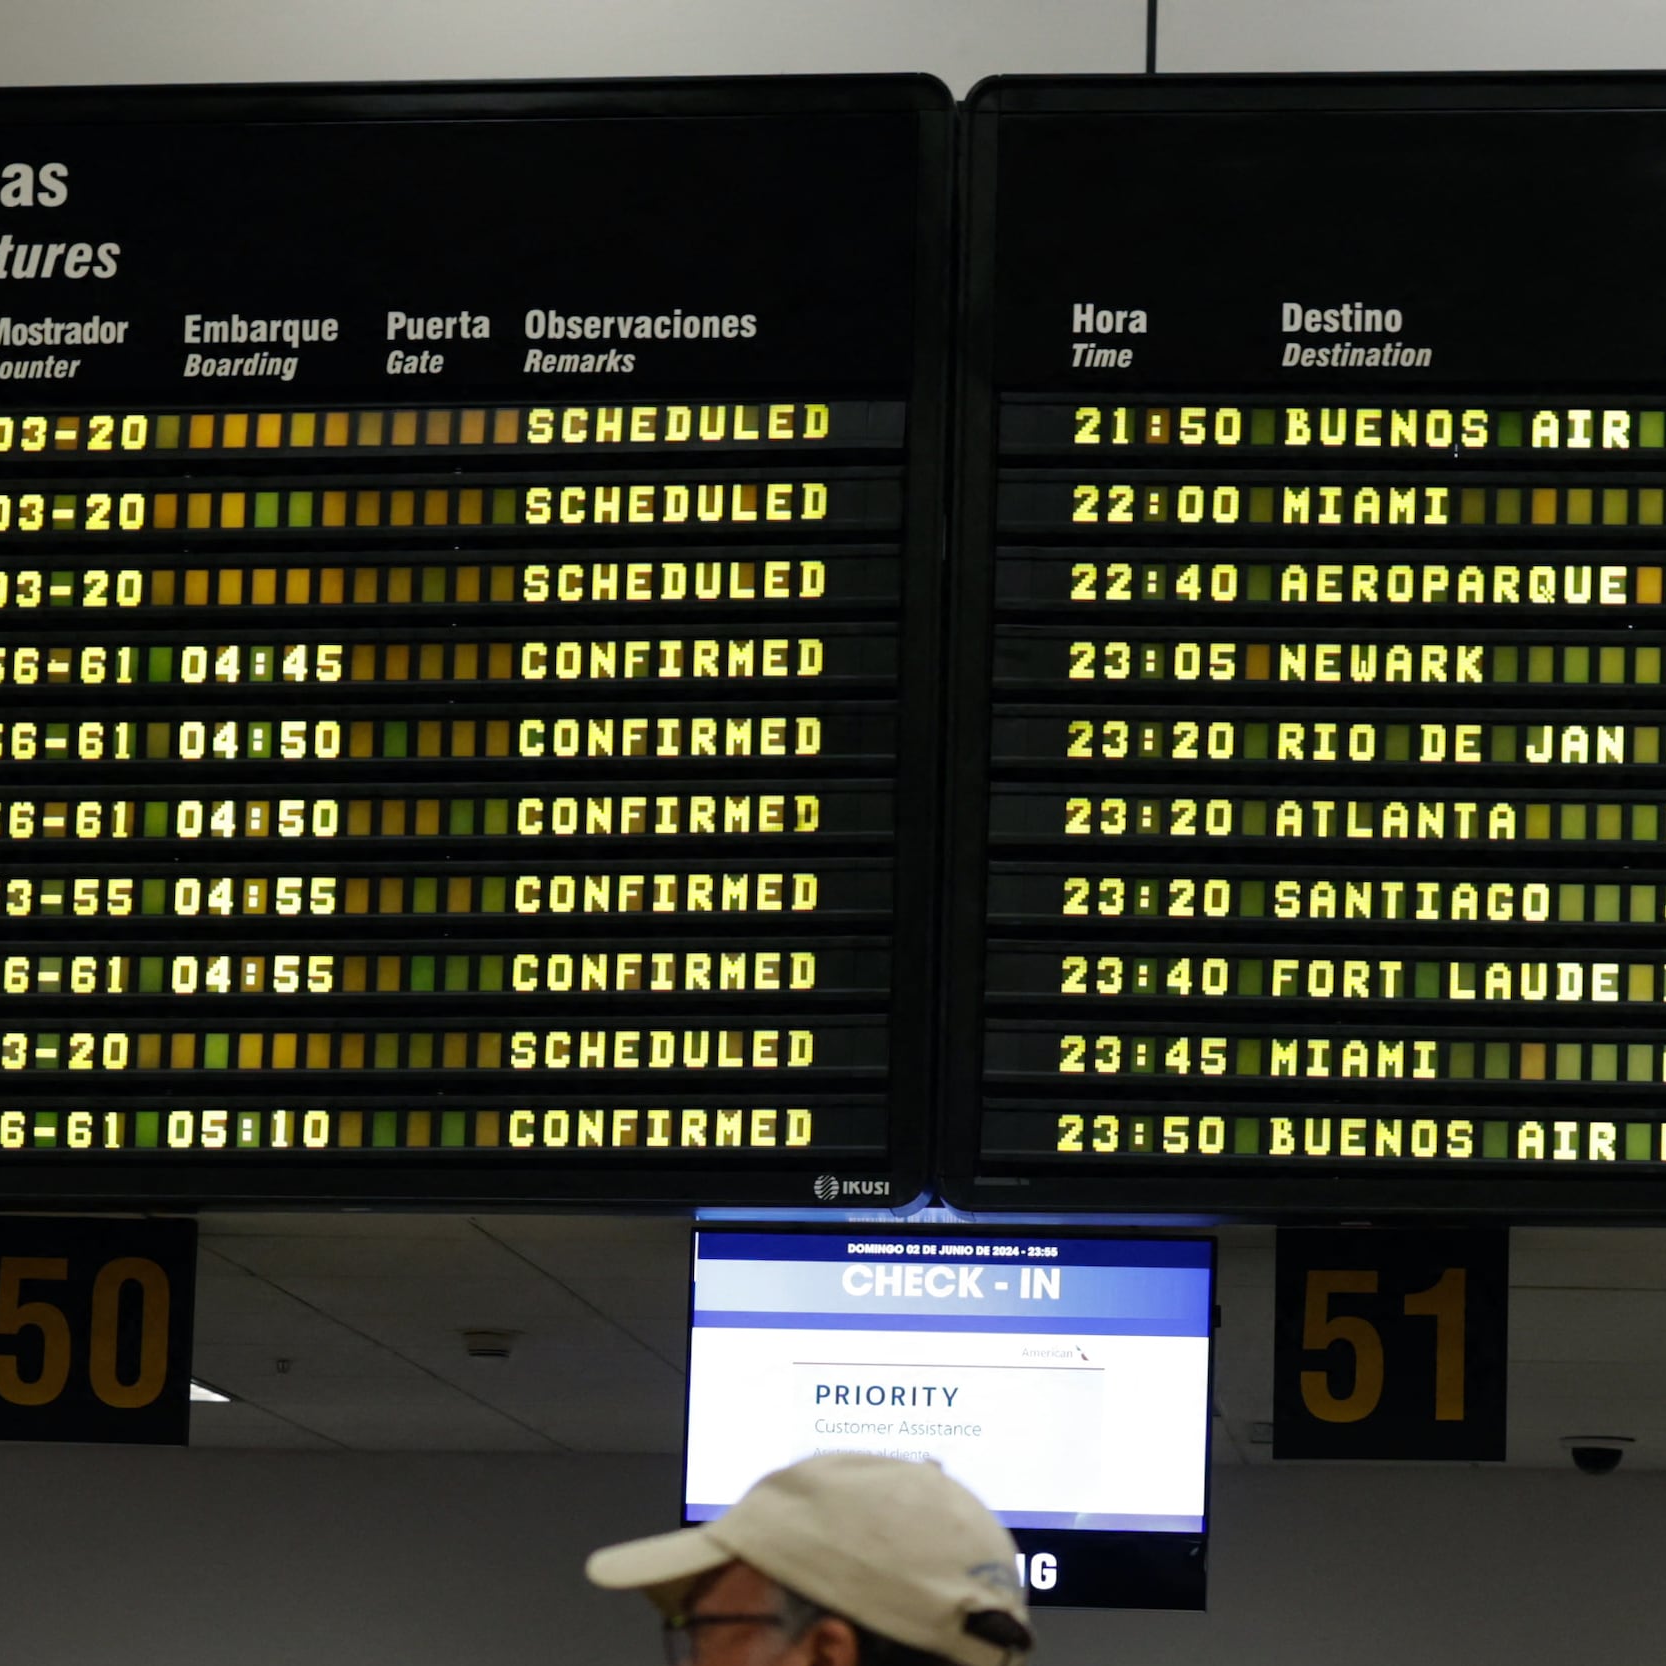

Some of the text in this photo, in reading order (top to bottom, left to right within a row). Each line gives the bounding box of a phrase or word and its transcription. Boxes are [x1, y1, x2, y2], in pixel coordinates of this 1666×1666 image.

[185, 315, 338, 348] Embarque
[387, 311, 489, 340] Puerta
[525, 309, 756, 339] Observaciones
[1073, 304, 1147, 333] Hora
[1283, 302, 1402, 332] Destino
[184, 352, 298, 381] Boarding
[387, 350, 443, 374] Gate
[524, 349, 635, 372] Remarks
[1073, 343, 1132, 367] Time
[1282, 342, 1431, 366] Destination
[528, 405, 827, 442] SCHEDULED
[1075, 408, 1240, 444] 21:50
[1285, 409, 1487, 446] BUENOS
[1533, 410, 1629, 448] AIR
[1072, 564, 1236, 600] 22:40
[1282, 566, 1626, 603] AEROPARQUE
[182, 645, 341, 682] 04:45
[522, 640, 822, 678] CONFIRMED
[1068, 722, 1233, 758] 23:20
[1279, 724, 1374, 760] RIO
[1421, 725, 1480, 761] DE
[1527, 726, 1623, 763] JAN
[172, 956, 333, 993] 04:55
[513, 953, 814, 990] CONFIRMED
[1062, 957, 1227, 995] 23:40
[1273, 960, 1401, 997] FORT
[1450, 963, 1618, 1001] LAUDE
[842, 1177, 889, 1197] IKUSI
[842, 1265, 984, 1298] CHECK
[1020, 1267, 1061, 1300] IN
[1022, 1347, 1073, 1358] American
[1300, 1266, 1468, 1424] 51
[815, 1384, 959, 1407] PRIORITY
[815, 1418, 982, 1437] Customer Assistance
